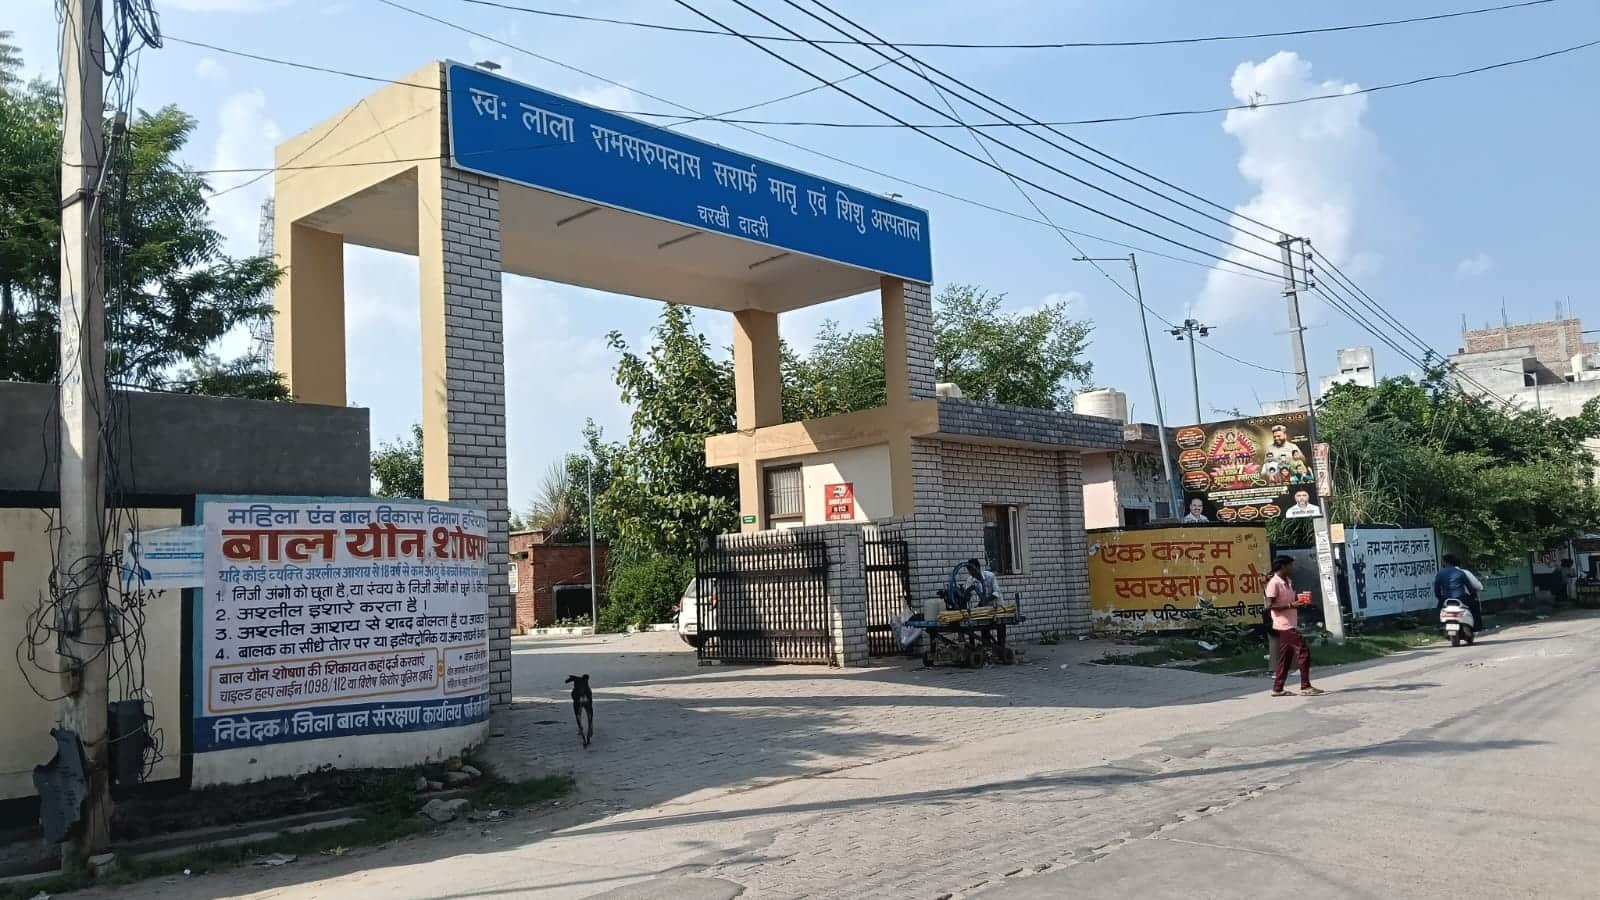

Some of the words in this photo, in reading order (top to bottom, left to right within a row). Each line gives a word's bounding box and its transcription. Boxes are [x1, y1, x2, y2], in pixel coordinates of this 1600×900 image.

[519, 102, 575, 143] लाला
[768, 178, 798, 215] मातृ
[807, 186, 827, 216] एवं
[835, 190, 866, 234] शिशु
[871, 208, 921, 241] अस्पताल
[697, 205, 731, 229] चरखी
[738, 215, 769, 238] दादरी
[227, 504, 299, 527] महिला
[340, 509, 371, 524] बाल
[376, 505, 424, 524] विकास
[427, 506, 459, 526] विभाग
[222, 529, 337, 560] बाल
[432, 526, 487, 560] शोषण
[1101, 543, 1146, 564] एक
[1150, 540, 1234, 563] कदम
[219, 565, 240, 584] यदि
[242, 564, 266, 583] कोई
[269, 564, 303, 581] व्यक्ति
[305, 563, 340, 580] अश्लील
[342, 567, 370, 578] आशय
[371, 562, 379, 577] से
[1114, 575, 1201, 601] स्वच्छता
[1205, 565, 1236, 596] की
[232, 585, 261, 600] निजी
[294, 584, 308, 599] को
[311, 586, 332, 602] छूता
[350, 584, 364, 596] या
[396, 580, 405, 594] के
[408, 579, 430, 595] निजी
[215, 608, 231, 621] 2.
[237, 602, 304, 620] अश्लील
[308, 600, 355, 620] इशारे
[360, 600, 402, 613] करता
[406, 596, 417, 613] है
[215, 628, 232, 641] 3.
[237, 620, 305, 640] अश्लील
[310, 619, 360, 635] आशय
[366, 616, 380, 630] से
[385, 616, 414, 630] शब्द
[416, 613, 448, 628] बोलता
[450, 612, 458, 628] है
[215, 647, 230, 660] 4.
[238, 644, 277, 659] बालक
[280, 643, 295, 656] का
[299, 637, 324, 654] सीधे
[353, 636, 370, 649] पर
[373, 635, 388, 648] या
[219, 671, 244, 684] बाल
[272, 665, 305, 680] शोषण
[308, 662, 321, 676] की
[325, 660, 367, 675] शिकायत
[220, 688, 252, 704] चाइल्ड
[277, 680, 302, 696] लाईन
[348, 678, 357, 690] या
[213, 716, 280, 743] निवेदक
[291, 711, 334, 735] जिला
[337, 710, 370, 730] बाल
[372, 704, 421, 728] संरक्षण
[423, 700, 462, 723] कार्यालय
